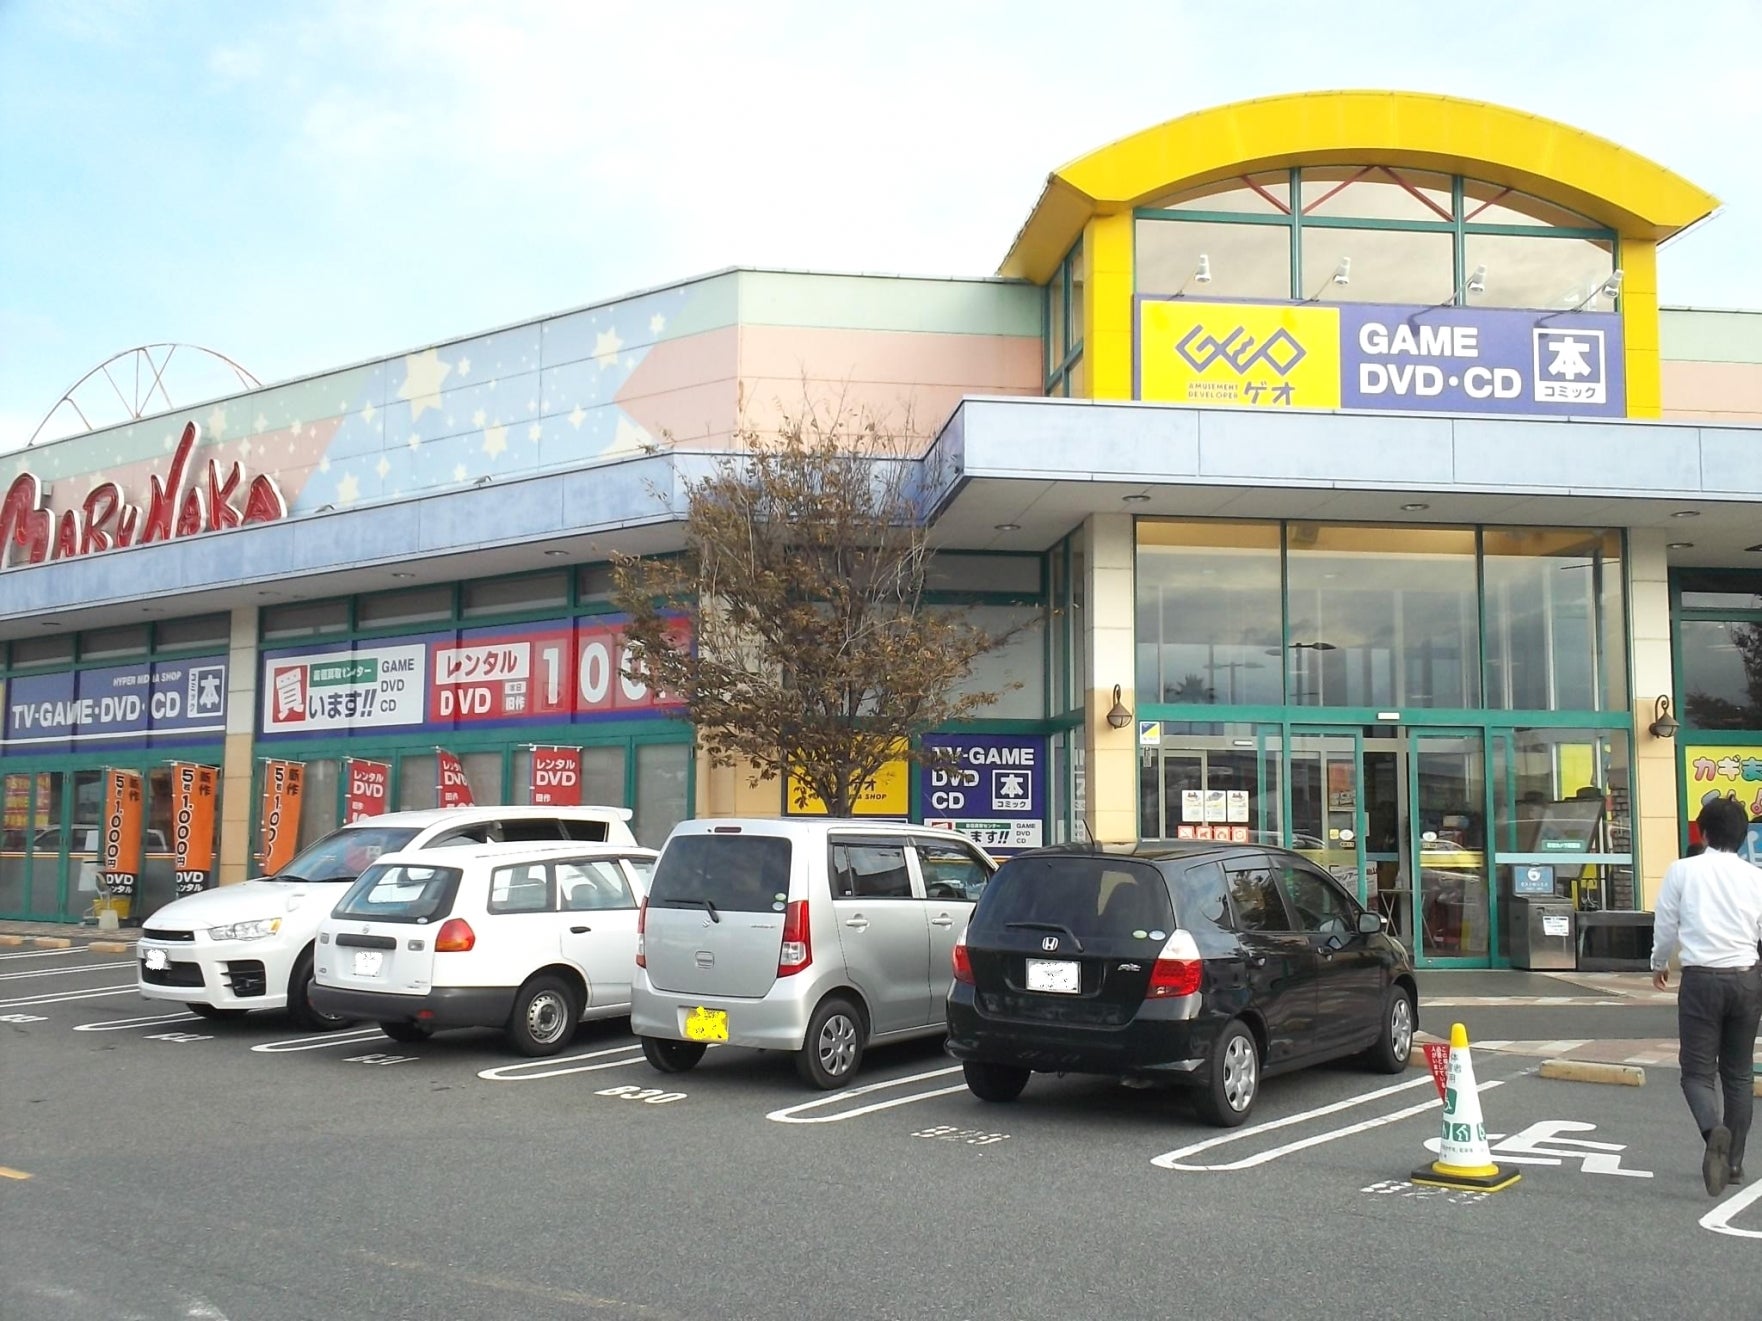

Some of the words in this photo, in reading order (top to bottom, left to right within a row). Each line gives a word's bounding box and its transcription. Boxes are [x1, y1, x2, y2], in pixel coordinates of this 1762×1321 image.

[1359, 322, 1479, 358] GAME
[1548, 336, 1592, 380] 本
[1188, 383, 1239, 391] AMUSEMENT
[1188, 391, 1239, 399] DEVELOPER
[1243, 381, 1296, 406] ゲオ
[1544, 385, 1596, 399] コミック
[381, 658, 415, 673] GAME
[447, 650, 518, 678] レンタル
[113, 676, 137, 688] HYPER
[161, 671, 182, 682] SHOP
[381, 679, 405, 693] DVD
[199, 674, 220, 709] 本
[380, 699, 397, 712] CD
[440, 687, 491, 716] DVD
[537, 758, 576, 770] レンタル
[354, 770, 384, 783] レンタル
[536, 771, 576, 786] DVD
[931, 769, 980, 787] DVD
[353, 781, 383, 798] DVD
[1000, 774, 1024, 798] 本
[931, 791, 965, 809] CD
[106, 874, 134, 885] DVD
[176, 872, 204, 883] DVD
[593, 1084, 688, 1104] B30
